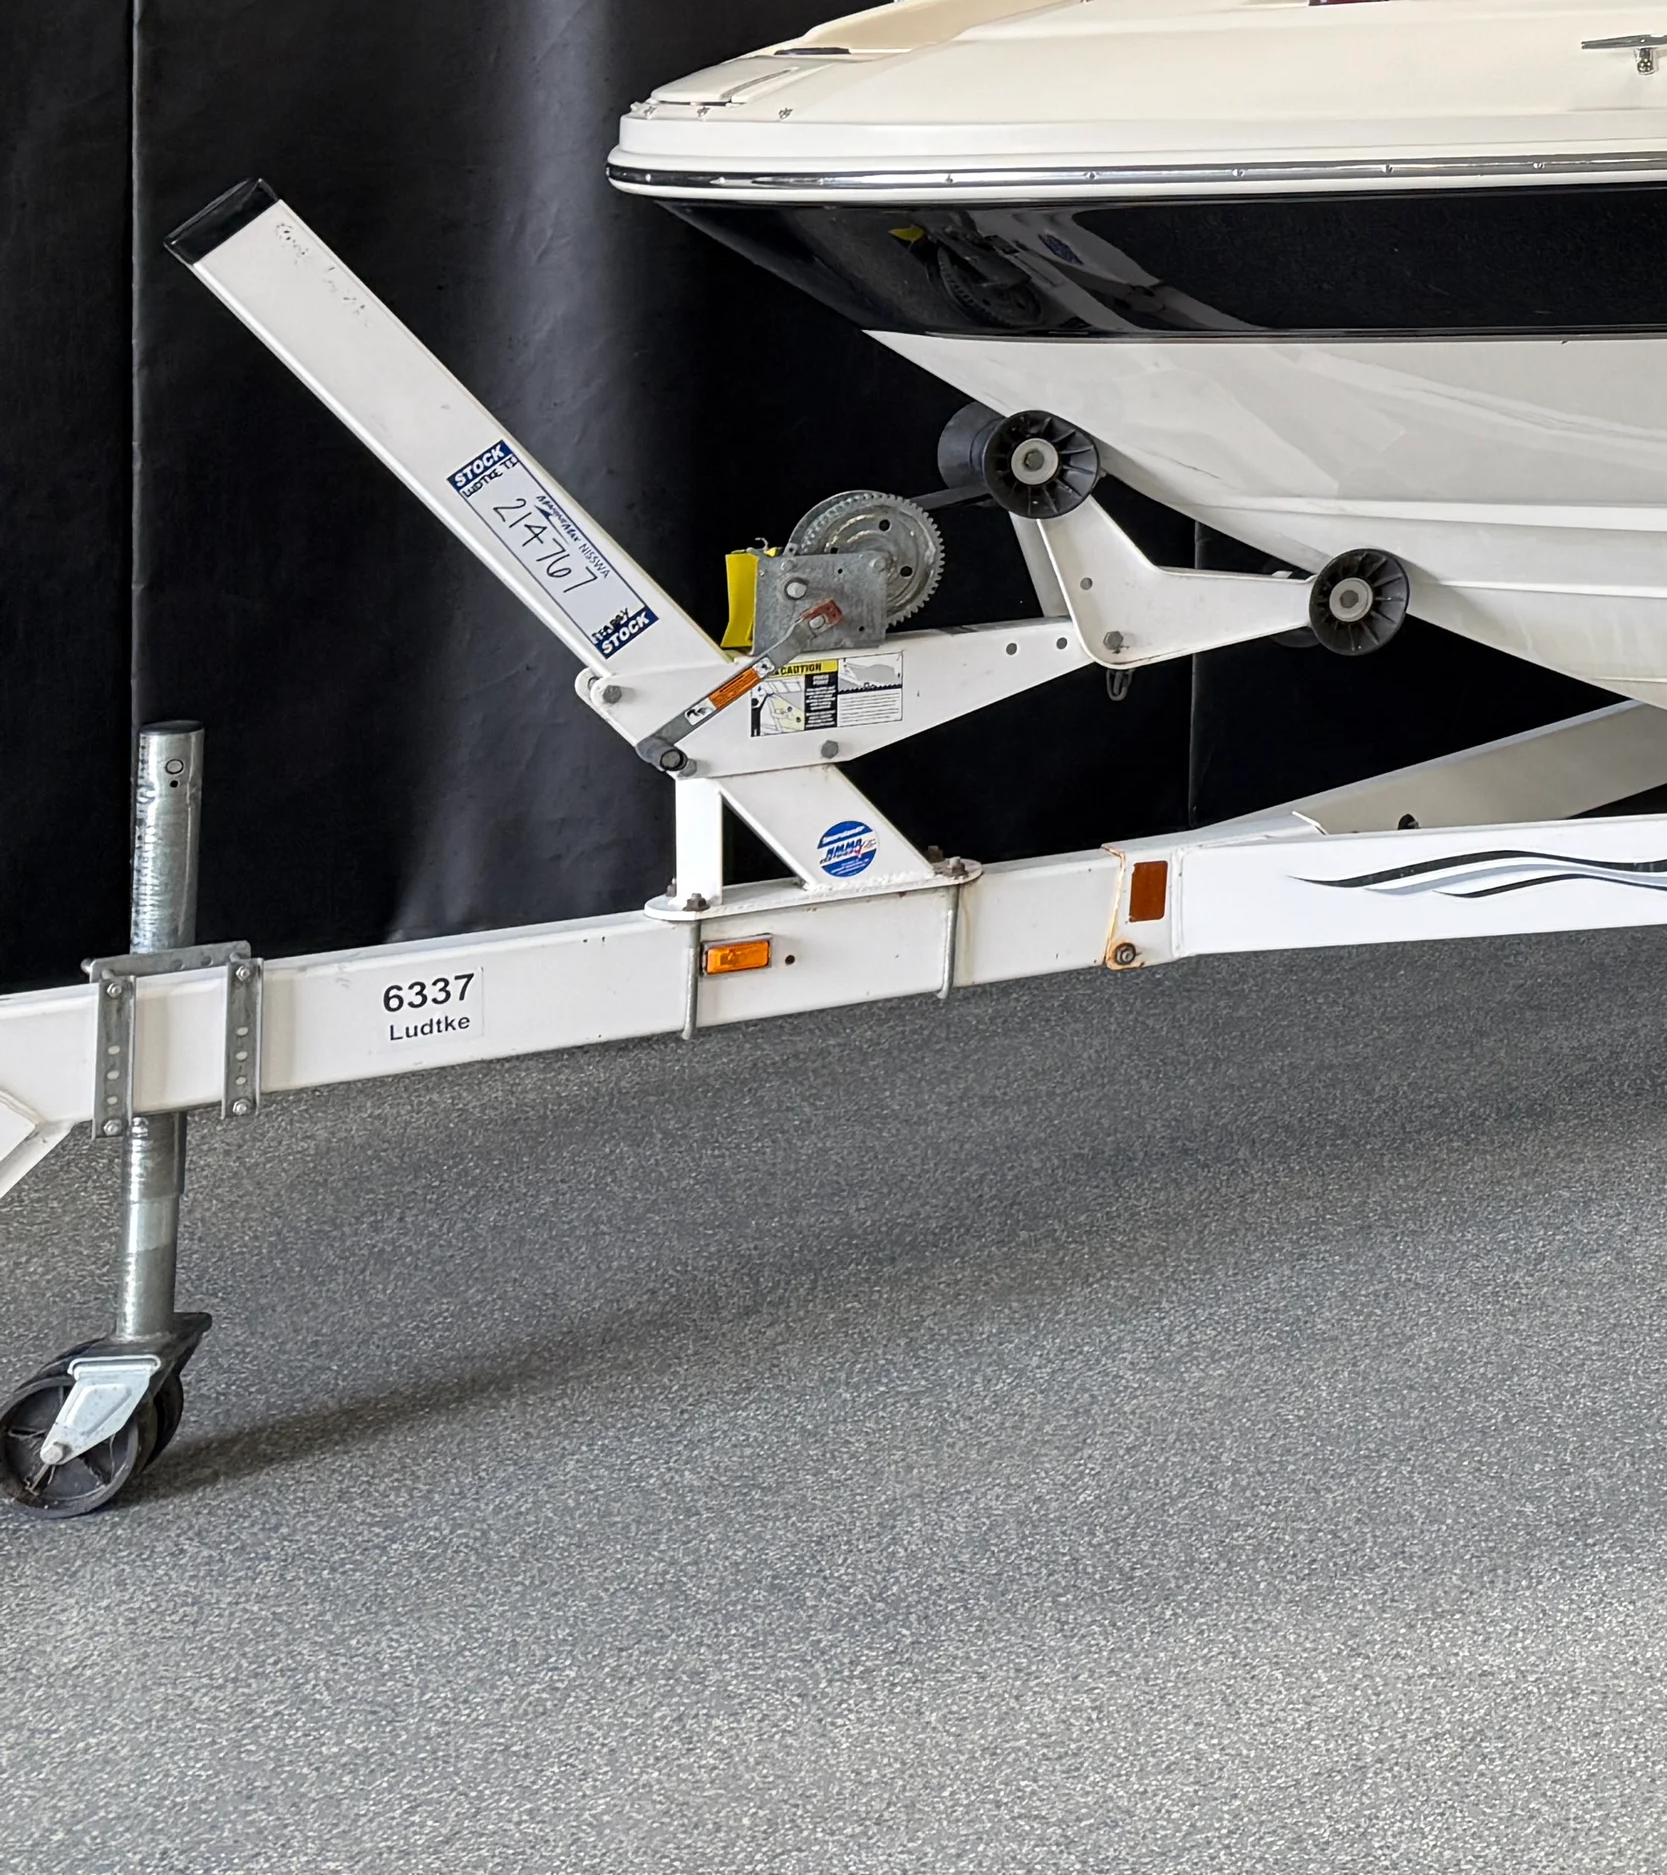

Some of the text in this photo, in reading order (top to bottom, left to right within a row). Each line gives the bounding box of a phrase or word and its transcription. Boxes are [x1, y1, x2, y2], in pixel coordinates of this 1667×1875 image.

[454, 443, 505, 487] STOCK
[493, 497, 598, 593] 214767
[578, 543, 611, 579] NISSWA
[601, 611, 650, 655] STOCK
[780, 662, 822, 676] CAUTION
[383, 972, 475, 1013] 6337
[389, 1015, 471, 1041] Ludtke
